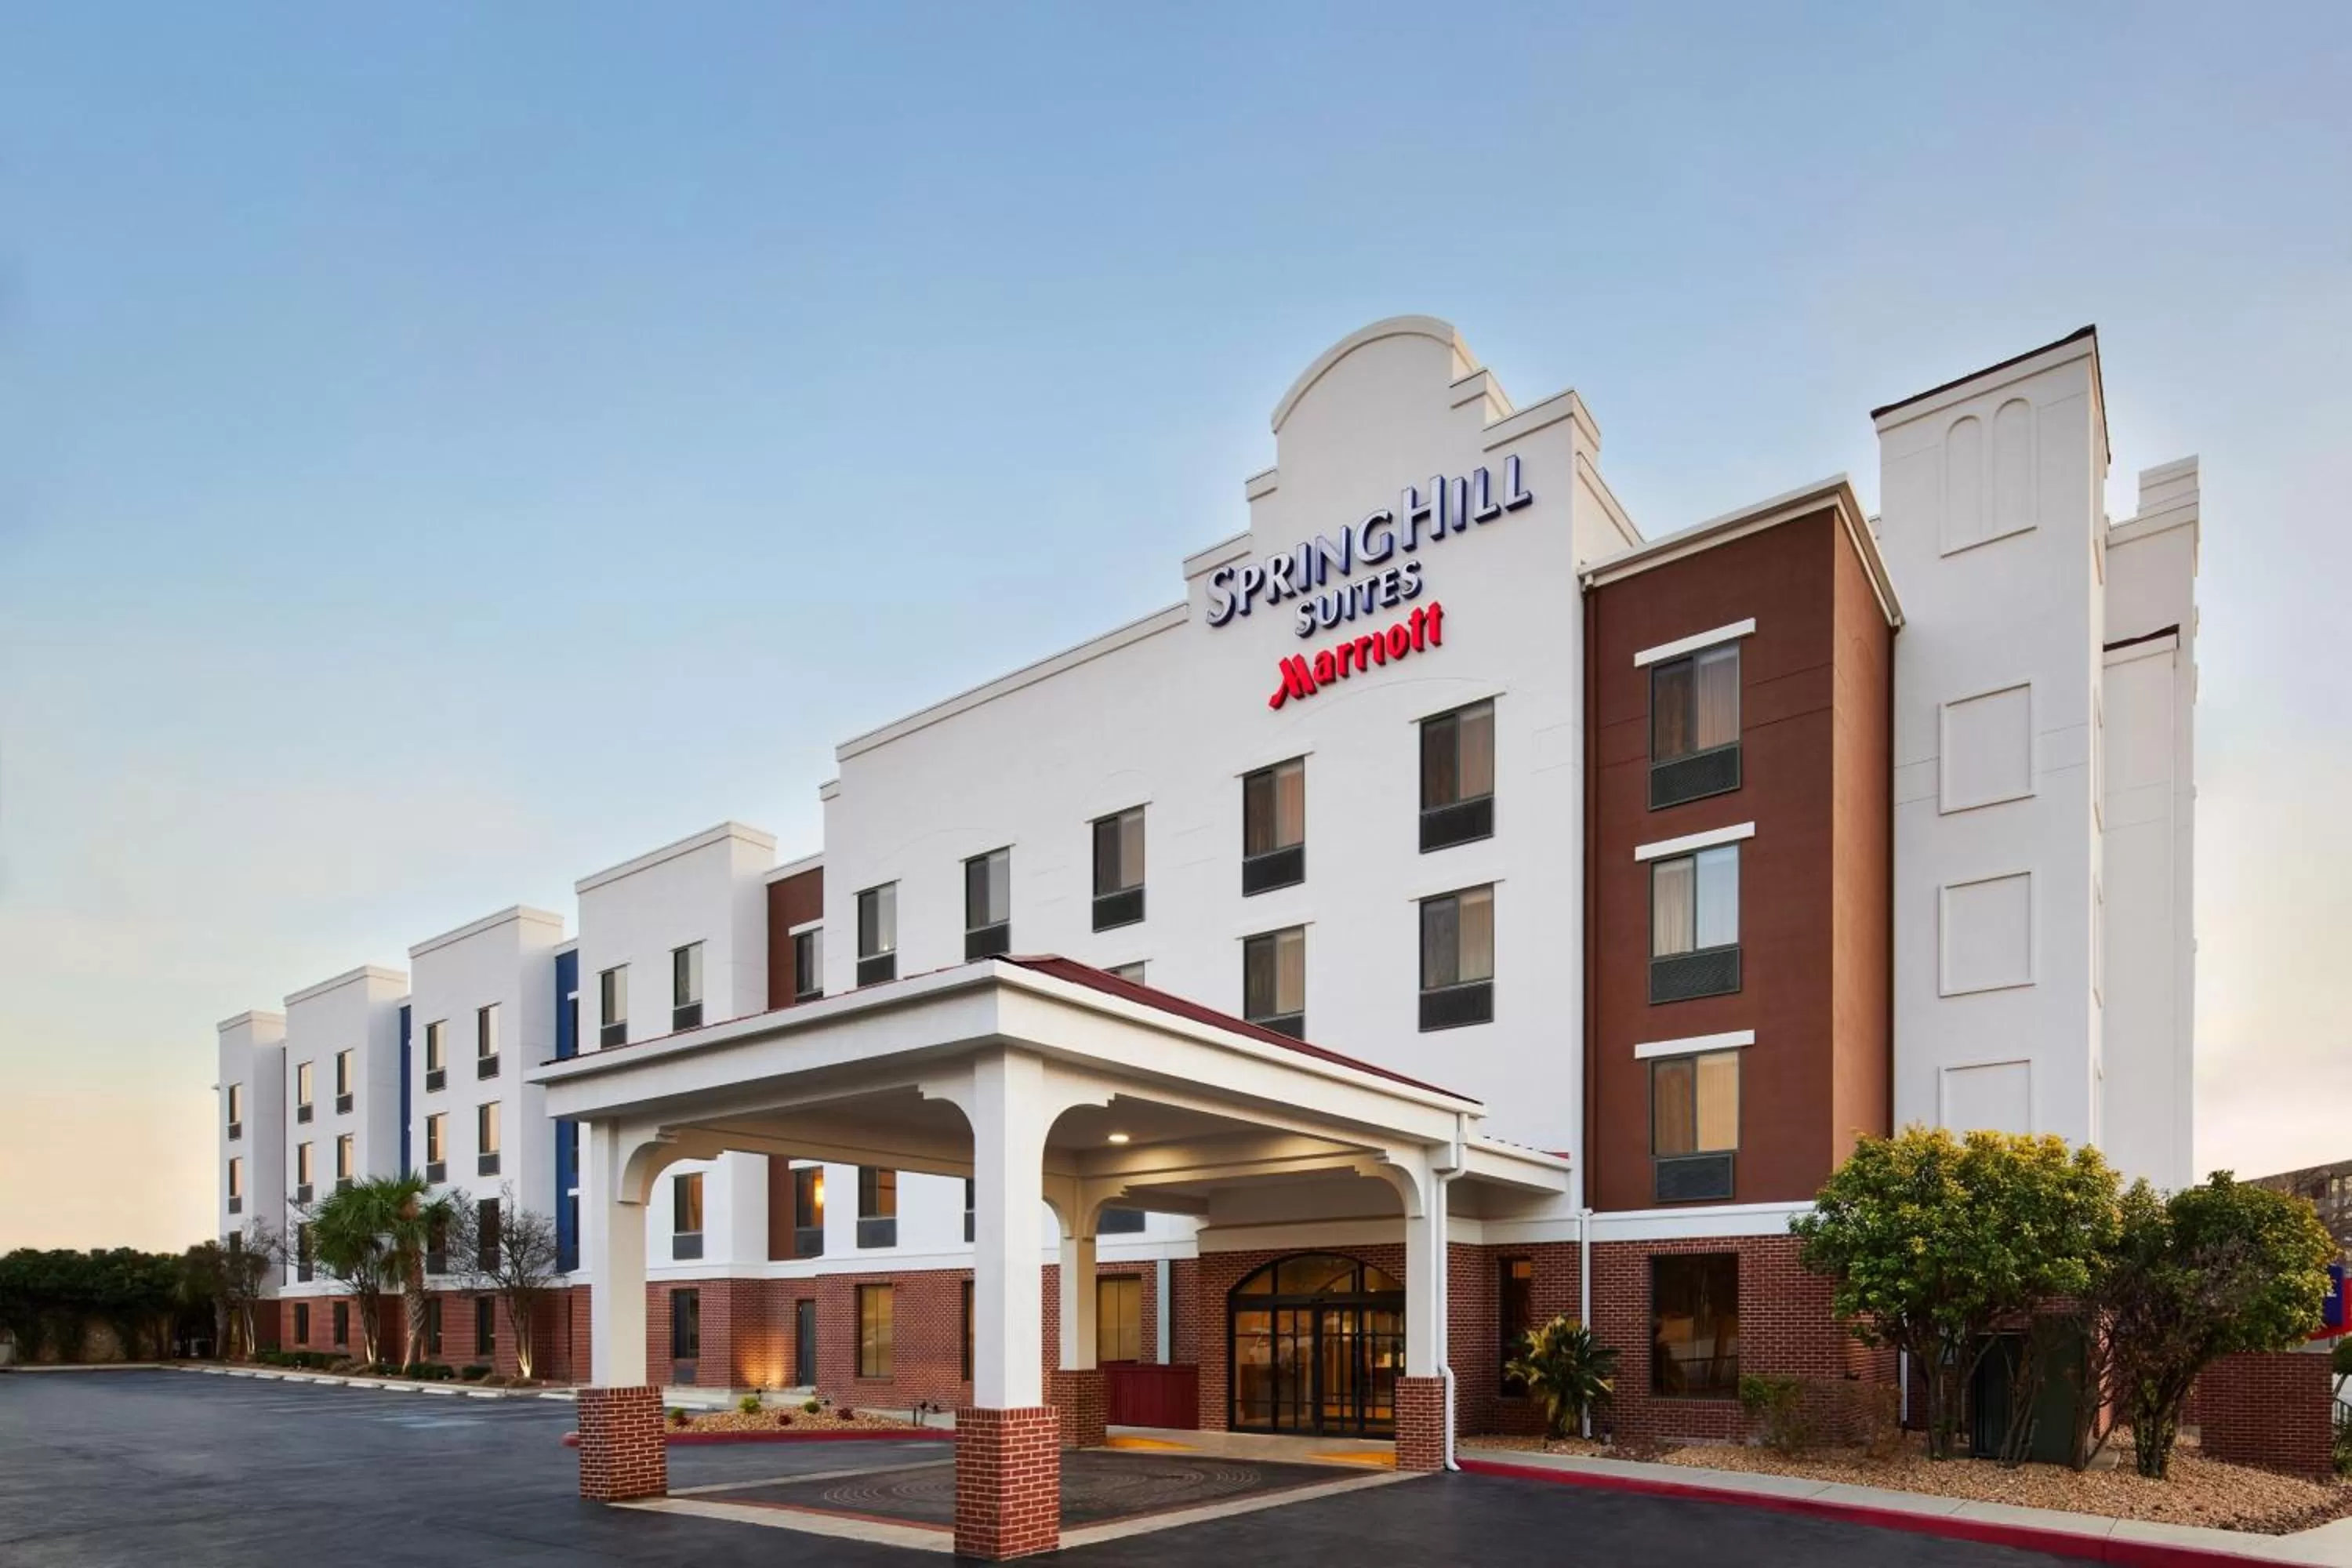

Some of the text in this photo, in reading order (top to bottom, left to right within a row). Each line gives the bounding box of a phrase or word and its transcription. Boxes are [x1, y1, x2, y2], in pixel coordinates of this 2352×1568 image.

[1207, 454, 1533, 626] SPRINGHILL
[1295, 559, 1422, 638] SUITES
[1269, 601, 1443, 710] Marriott
